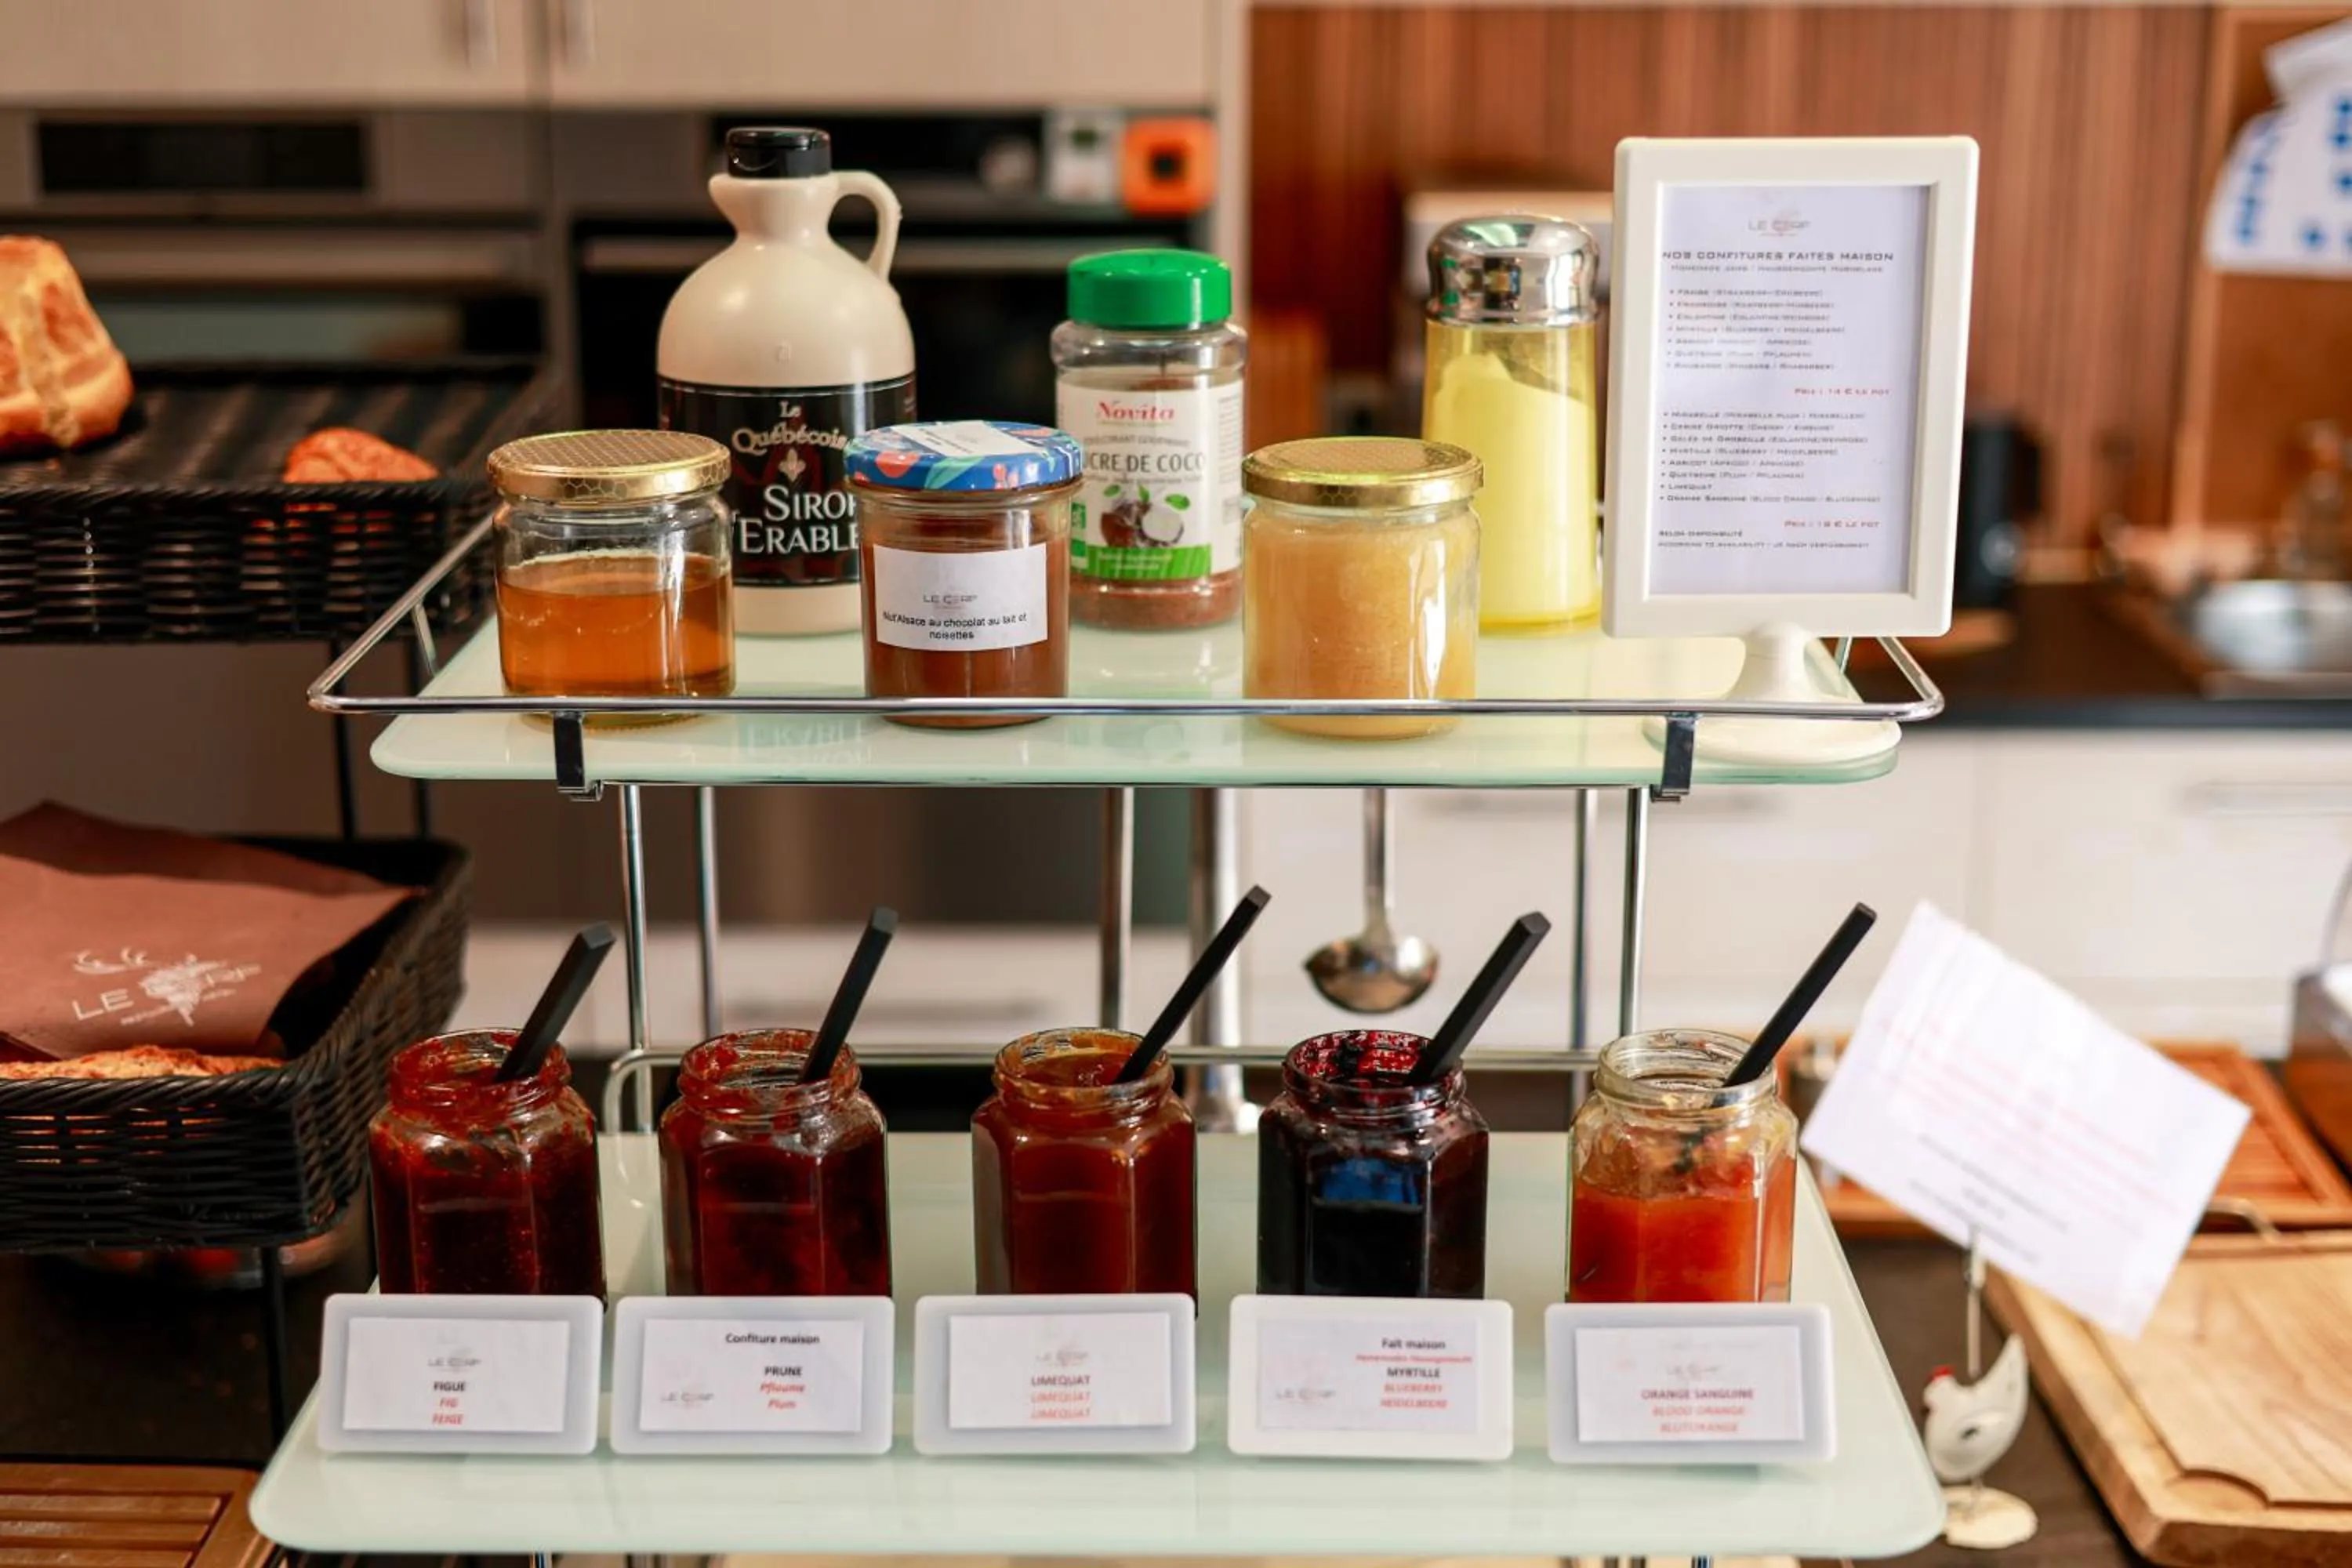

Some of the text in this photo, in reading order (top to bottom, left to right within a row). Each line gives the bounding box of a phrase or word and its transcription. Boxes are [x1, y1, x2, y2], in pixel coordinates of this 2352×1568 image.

[1697, 252, 1783, 260] CONFITURES
[1788, 252, 1835, 260] FAITES
[1840, 252, 1894, 261] MAISON
[779, 400, 801, 418] Le
[1098, 399, 1175, 421] Novita
[1087, 452, 1120, 472] CRE
[1127, 455, 1151, 472] DE
[928, 619, 942, 627] au
[943, 617, 985, 627] chocolat
[987, 618, 1000, 626] au
[929, 630, 975, 641] noisettes
[725, 1333, 821, 1345] Confiture maison
[1381, 1338, 1446, 1350] Fait maison
[764, 1366, 803, 1377] PRUNE
[1387, 1367, 1441, 1378] MYRTILLE
[433, 1381, 467, 1392] FIGUE
[1031, 1375, 1091, 1387] LIMEQUAT
[1030, 1391, 1092, 1403] LIMEQUAT
[1641, 1389, 1755, 1400] ORANGE SANGUINE
[439, 1397, 459, 1409] FIG
[768, 1399, 797, 1410] Plum
[1030, 1408, 1092, 1420] LIMEQUAT
